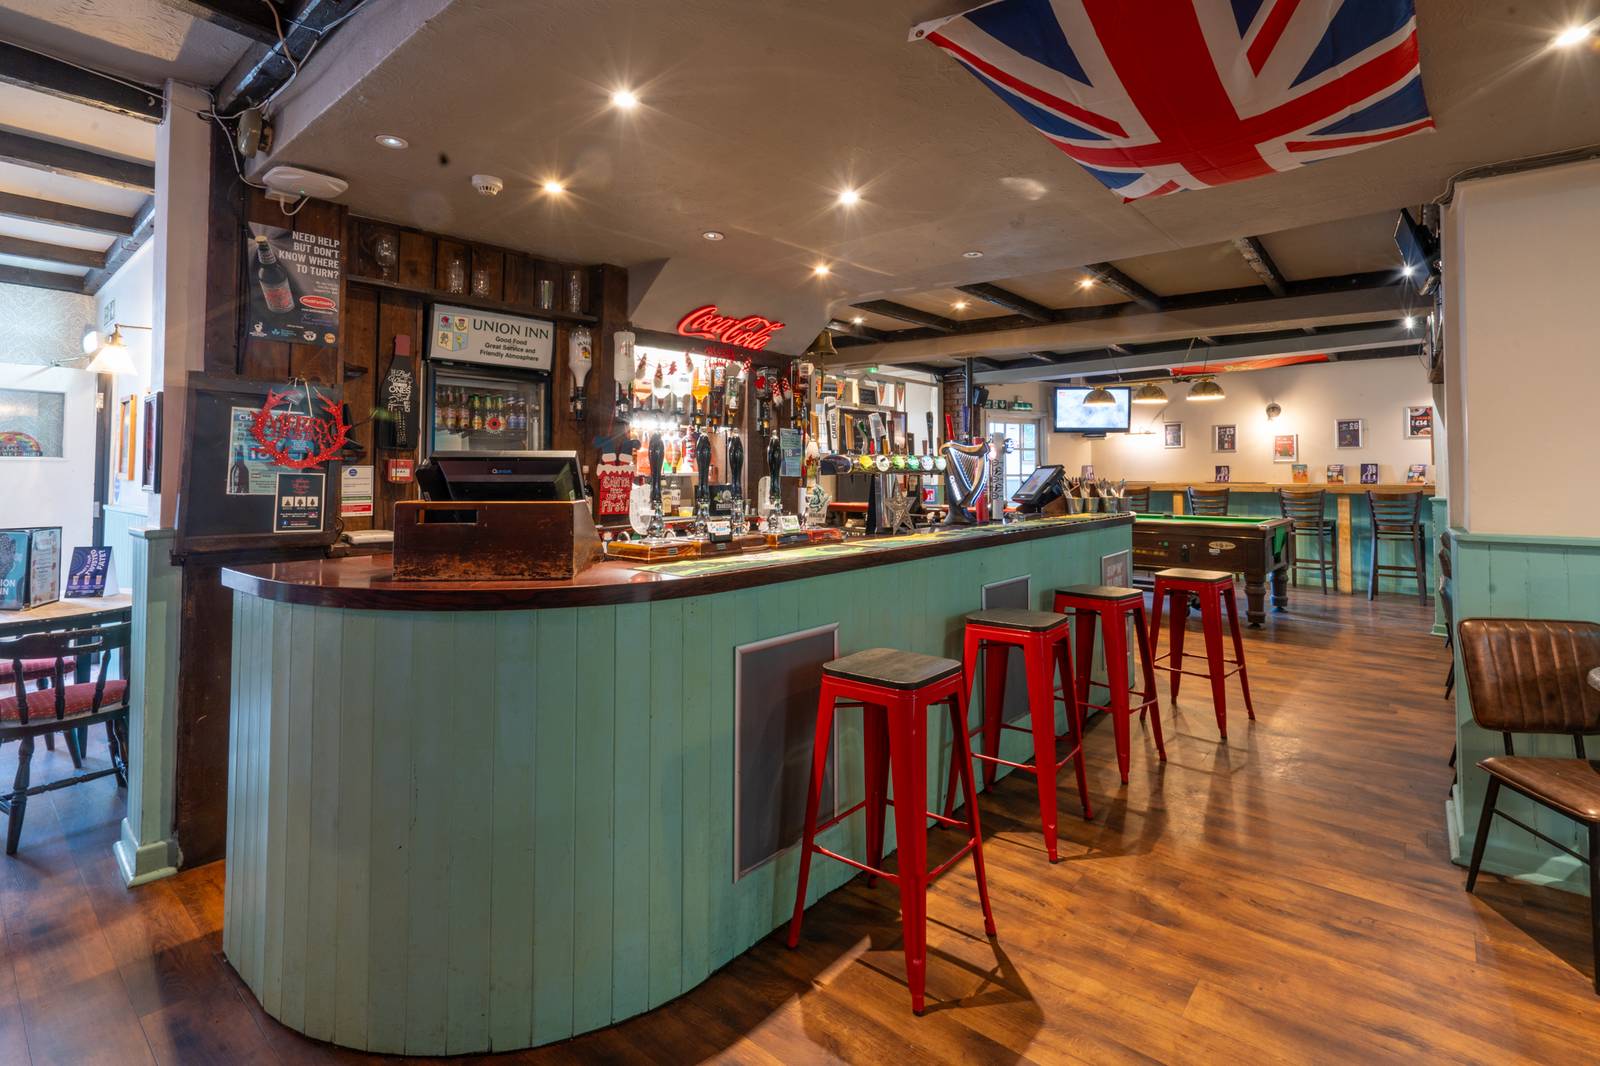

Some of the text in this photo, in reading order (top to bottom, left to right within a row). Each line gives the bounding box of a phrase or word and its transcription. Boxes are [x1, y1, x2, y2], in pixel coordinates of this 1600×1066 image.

[292, 231, 340, 248] NEED HELP
[293, 242, 340, 259] BUT DON'T
[278, 250, 340, 269] KNOW WHERE
[295, 263, 339, 280] TO TURN?
[473, 318, 549, 340] UNION INN
[485, 342, 502, 350] Great
[495, 336, 528, 346] Good Food
[479, 349, 504, 359] Friendly
